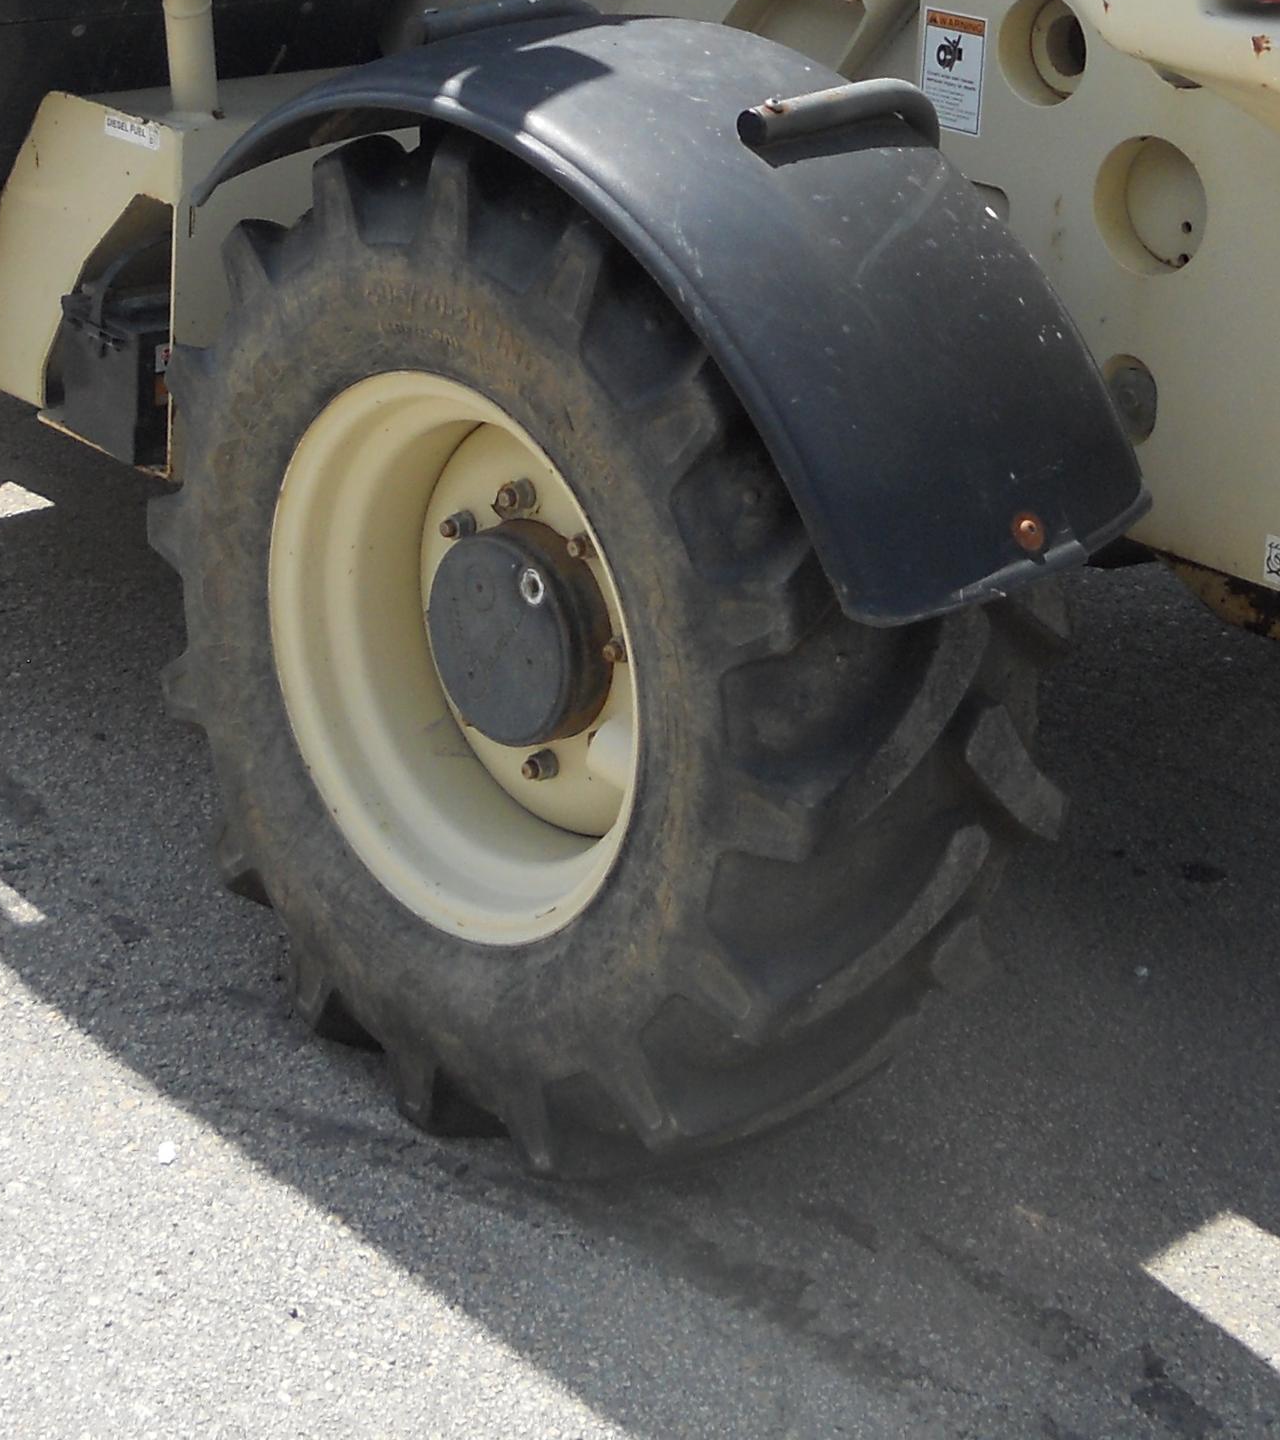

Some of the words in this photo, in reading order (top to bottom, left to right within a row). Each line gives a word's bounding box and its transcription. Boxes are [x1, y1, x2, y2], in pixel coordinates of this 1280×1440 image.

[939, 15, 983, 33] WARNING
[106, 118, 129, 133] DIESEL
[130, 123, 146, 138] FUEL
